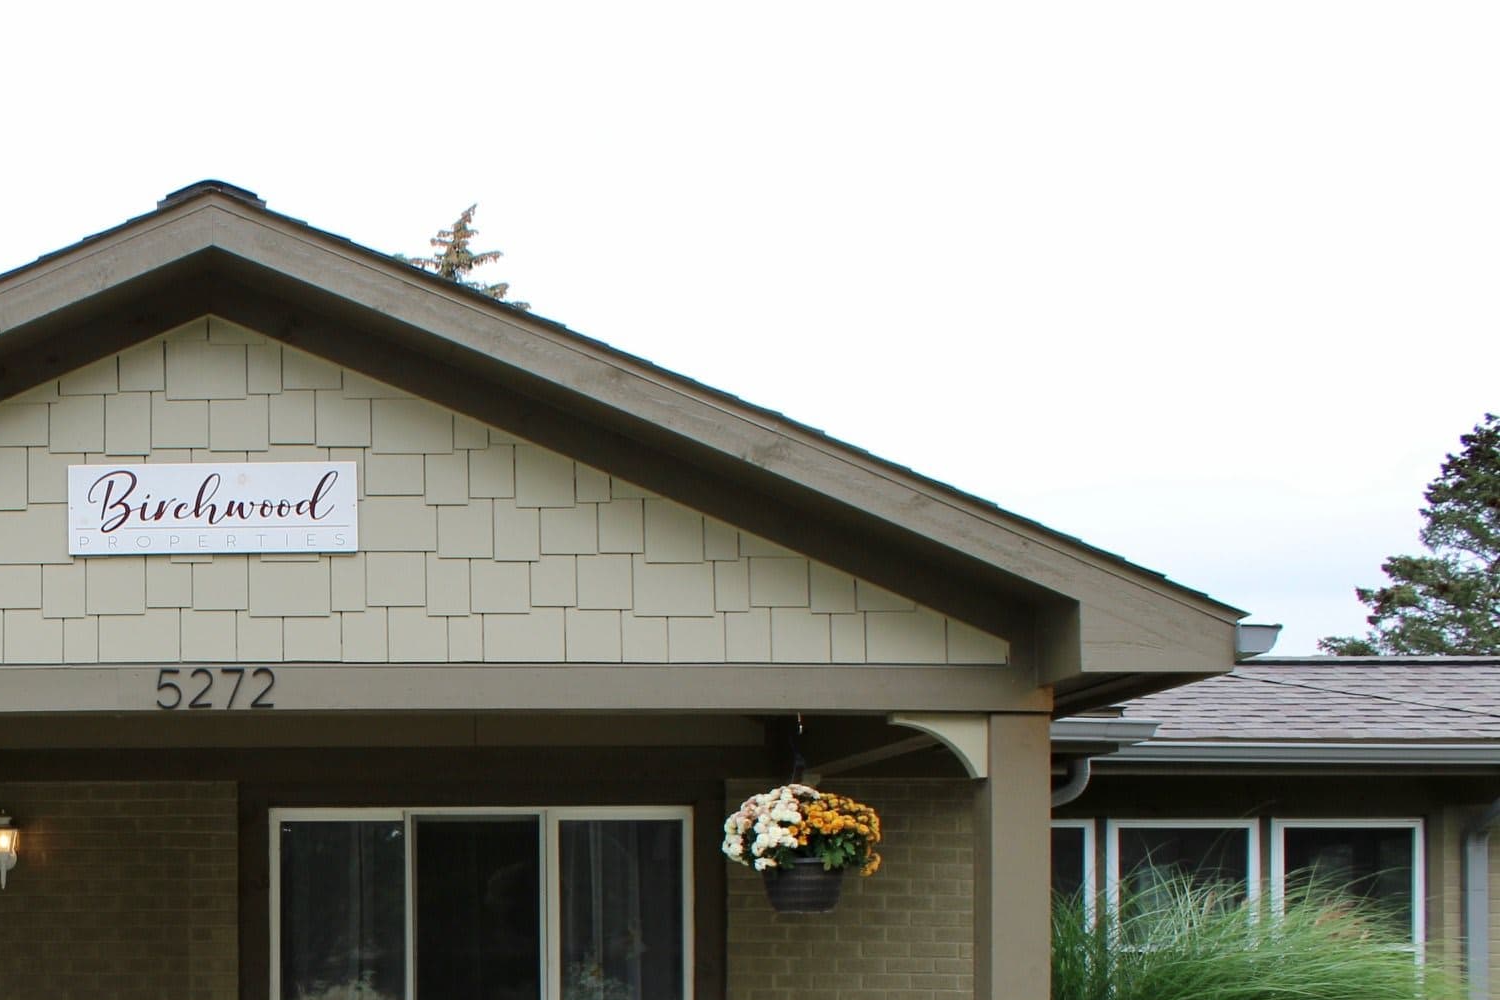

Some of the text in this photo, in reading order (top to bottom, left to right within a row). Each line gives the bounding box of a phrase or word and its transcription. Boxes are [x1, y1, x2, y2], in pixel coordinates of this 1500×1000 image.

[88, 470, 338, 532] Birchwood
[79, 533, 347, 549] PROPERTIES
[156, 667, 275, 710] 5272
